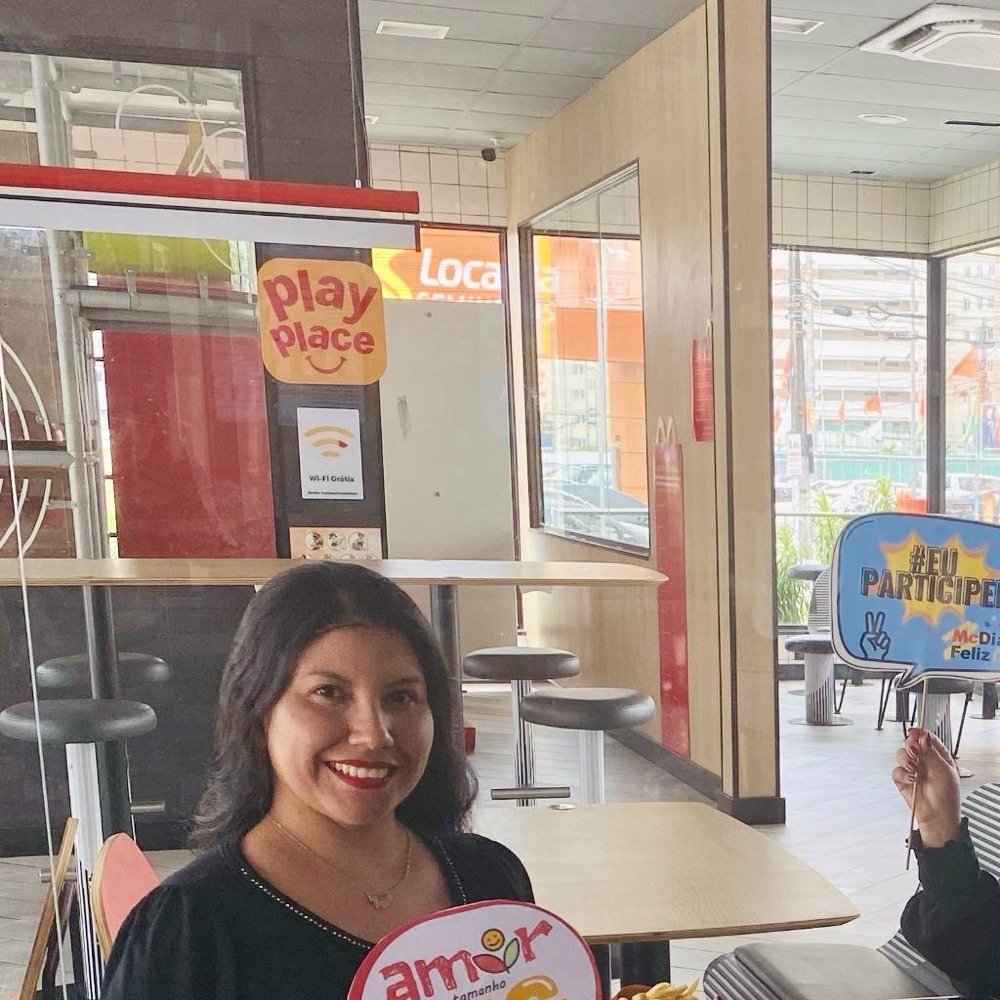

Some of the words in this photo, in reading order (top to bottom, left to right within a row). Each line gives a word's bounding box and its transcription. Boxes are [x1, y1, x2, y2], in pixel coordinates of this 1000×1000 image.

[262, 269, 378, 325] play
[270, 321, 375, 358] place
[909, 544, 959, 576] #EU
[950, 645, 991, 662] Feliz
